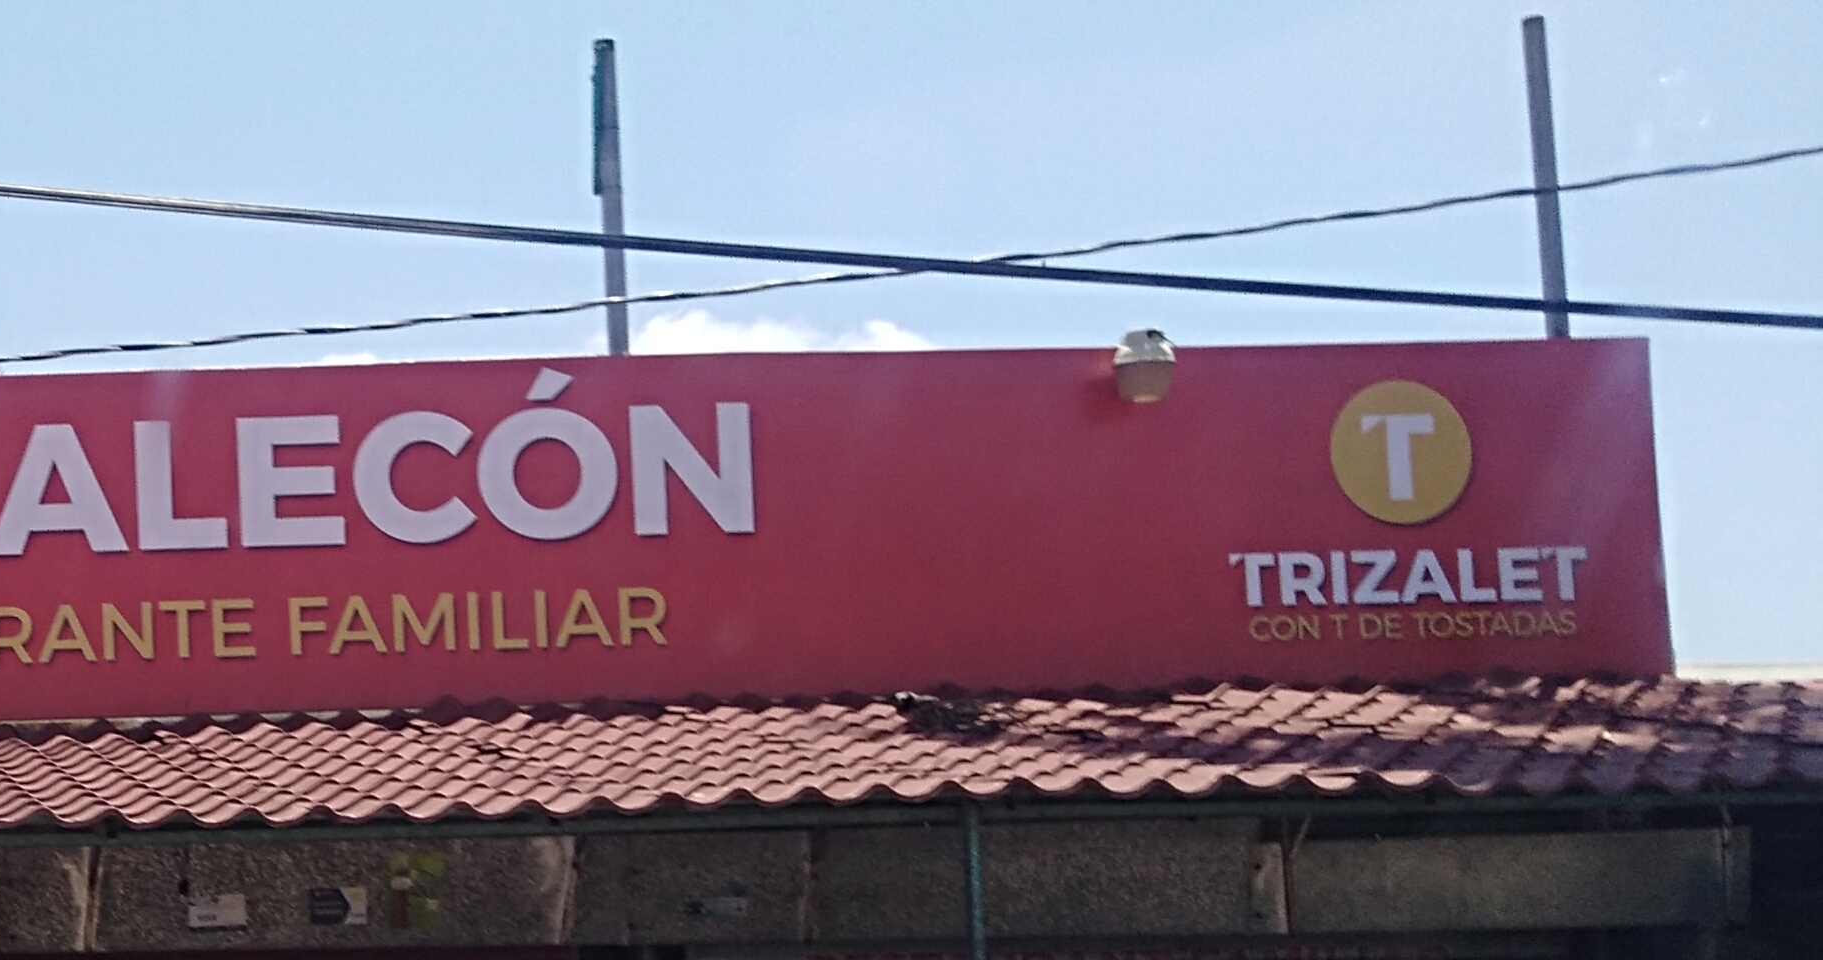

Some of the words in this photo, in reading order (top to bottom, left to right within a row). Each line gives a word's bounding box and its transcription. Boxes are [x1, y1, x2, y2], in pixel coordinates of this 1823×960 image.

[1360, 413, 1435, 501] T
[1228, 546, 1588, 607] TRIZALET
[288, 586, 669, 656] FAMILIAR
[1249, 613, 1320, 643] CON
[1329, 612, 1351, 641] T
[1360, 611, 1403, 641] DE
[1413, 608, 1577, 639] TOSTADAS
